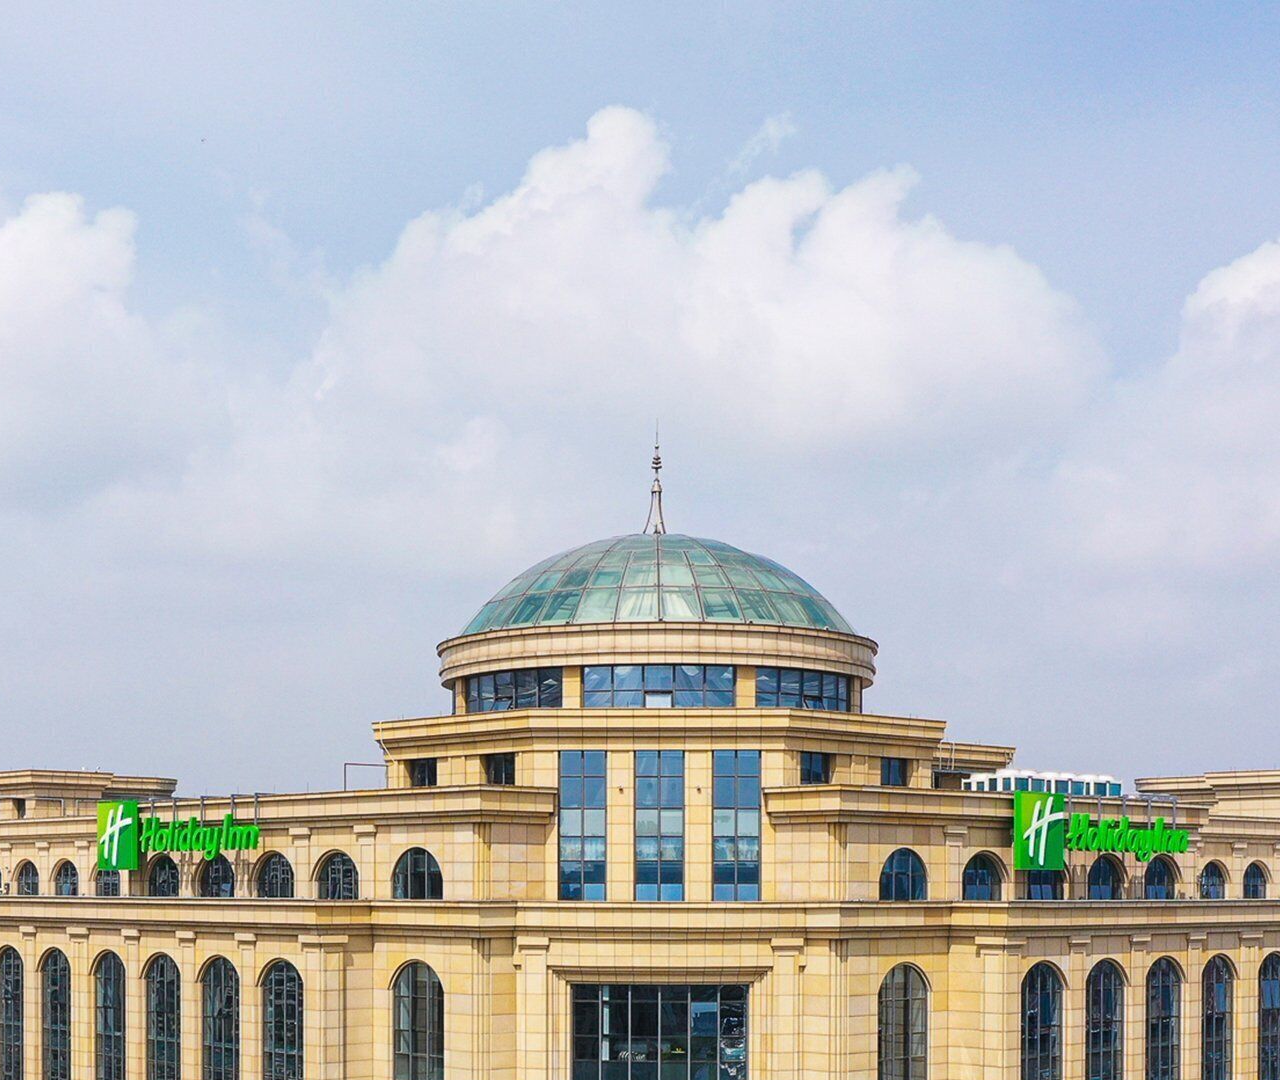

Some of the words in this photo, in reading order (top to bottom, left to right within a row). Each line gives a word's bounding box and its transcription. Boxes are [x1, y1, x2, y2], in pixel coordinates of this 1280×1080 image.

[140, 817, 223, 861] Holiday
[222, 814, 259, 850] Inn
[1066, 813, 1154, 862] Holiday
[1153, 817, 1189, 853] Inn
